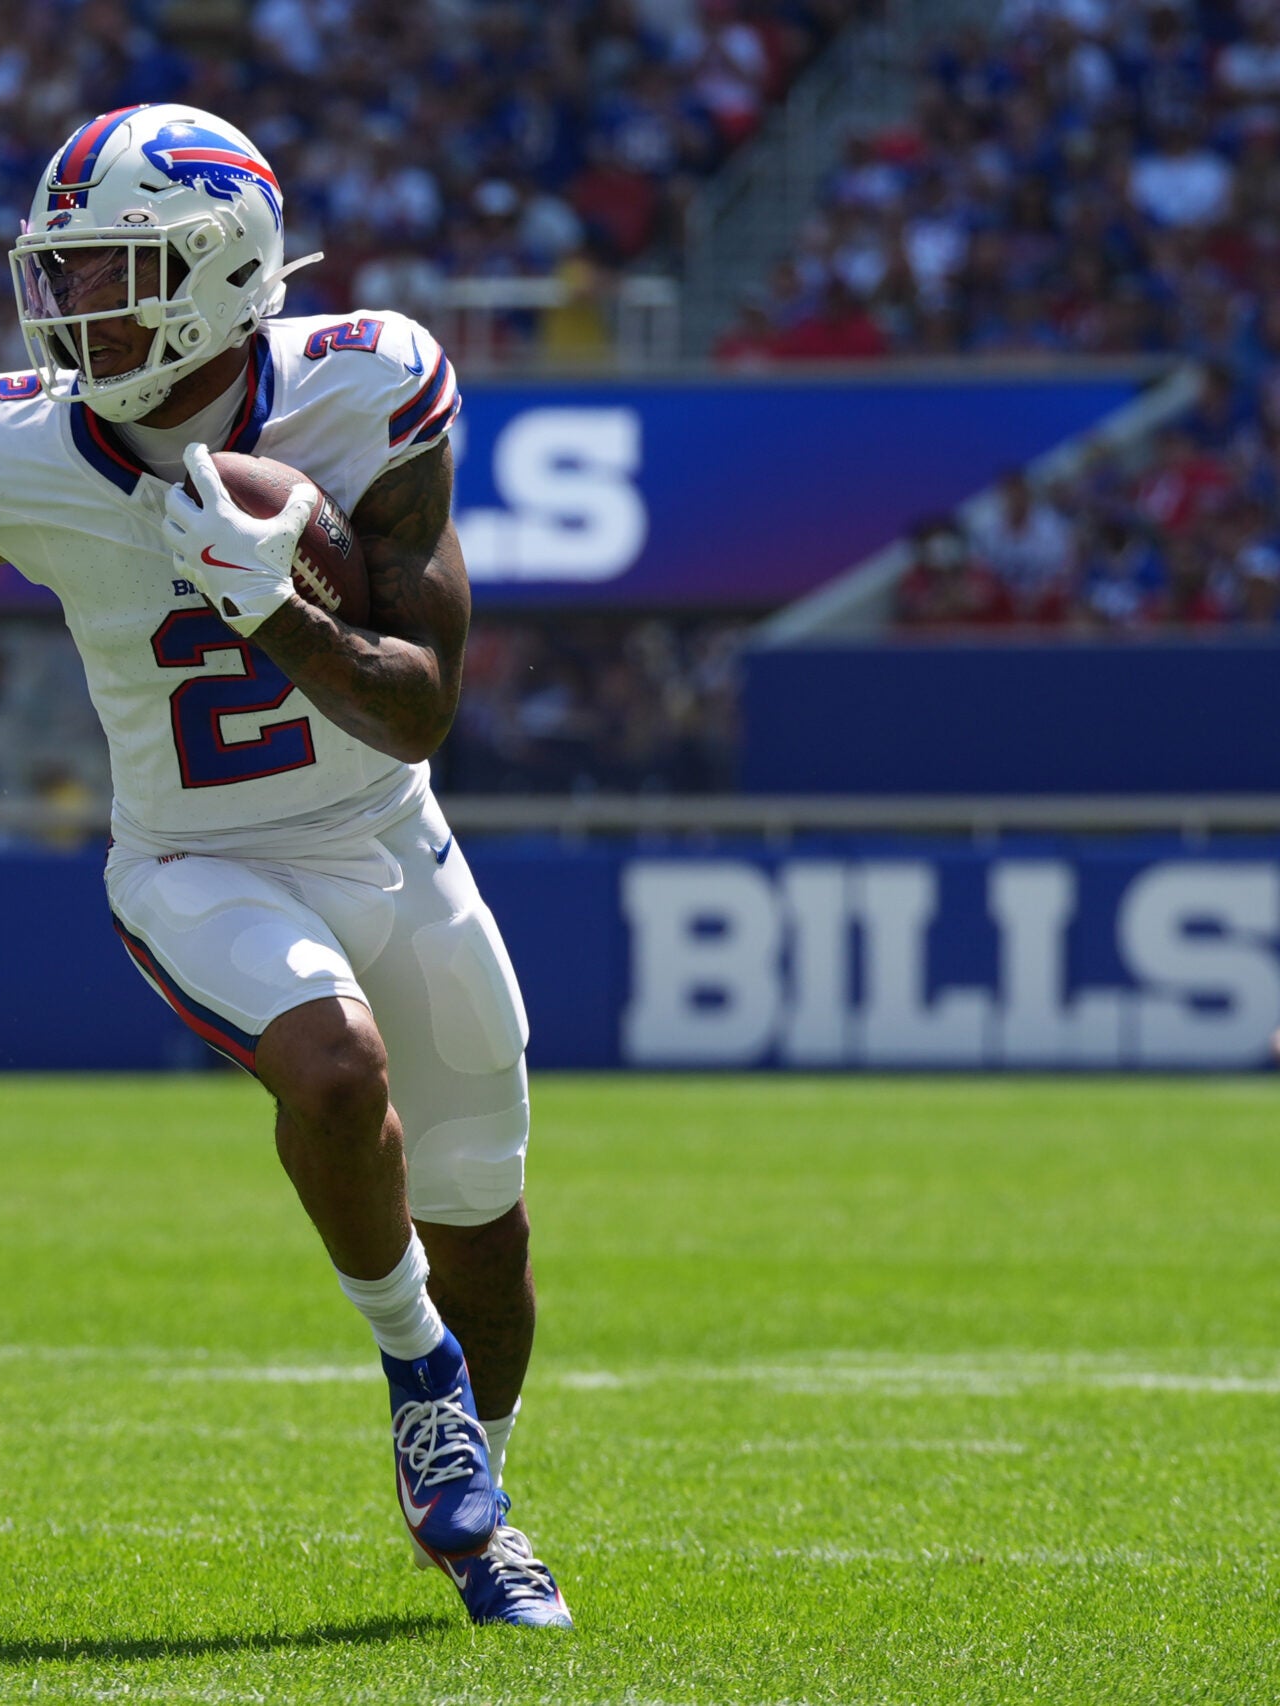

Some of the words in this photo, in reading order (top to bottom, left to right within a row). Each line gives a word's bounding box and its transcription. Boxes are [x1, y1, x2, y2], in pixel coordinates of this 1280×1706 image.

[303, 318, 385, 361] 2
[150, 606, 316, 788] 2
[622, 860, 1280, 1065] BILLS
